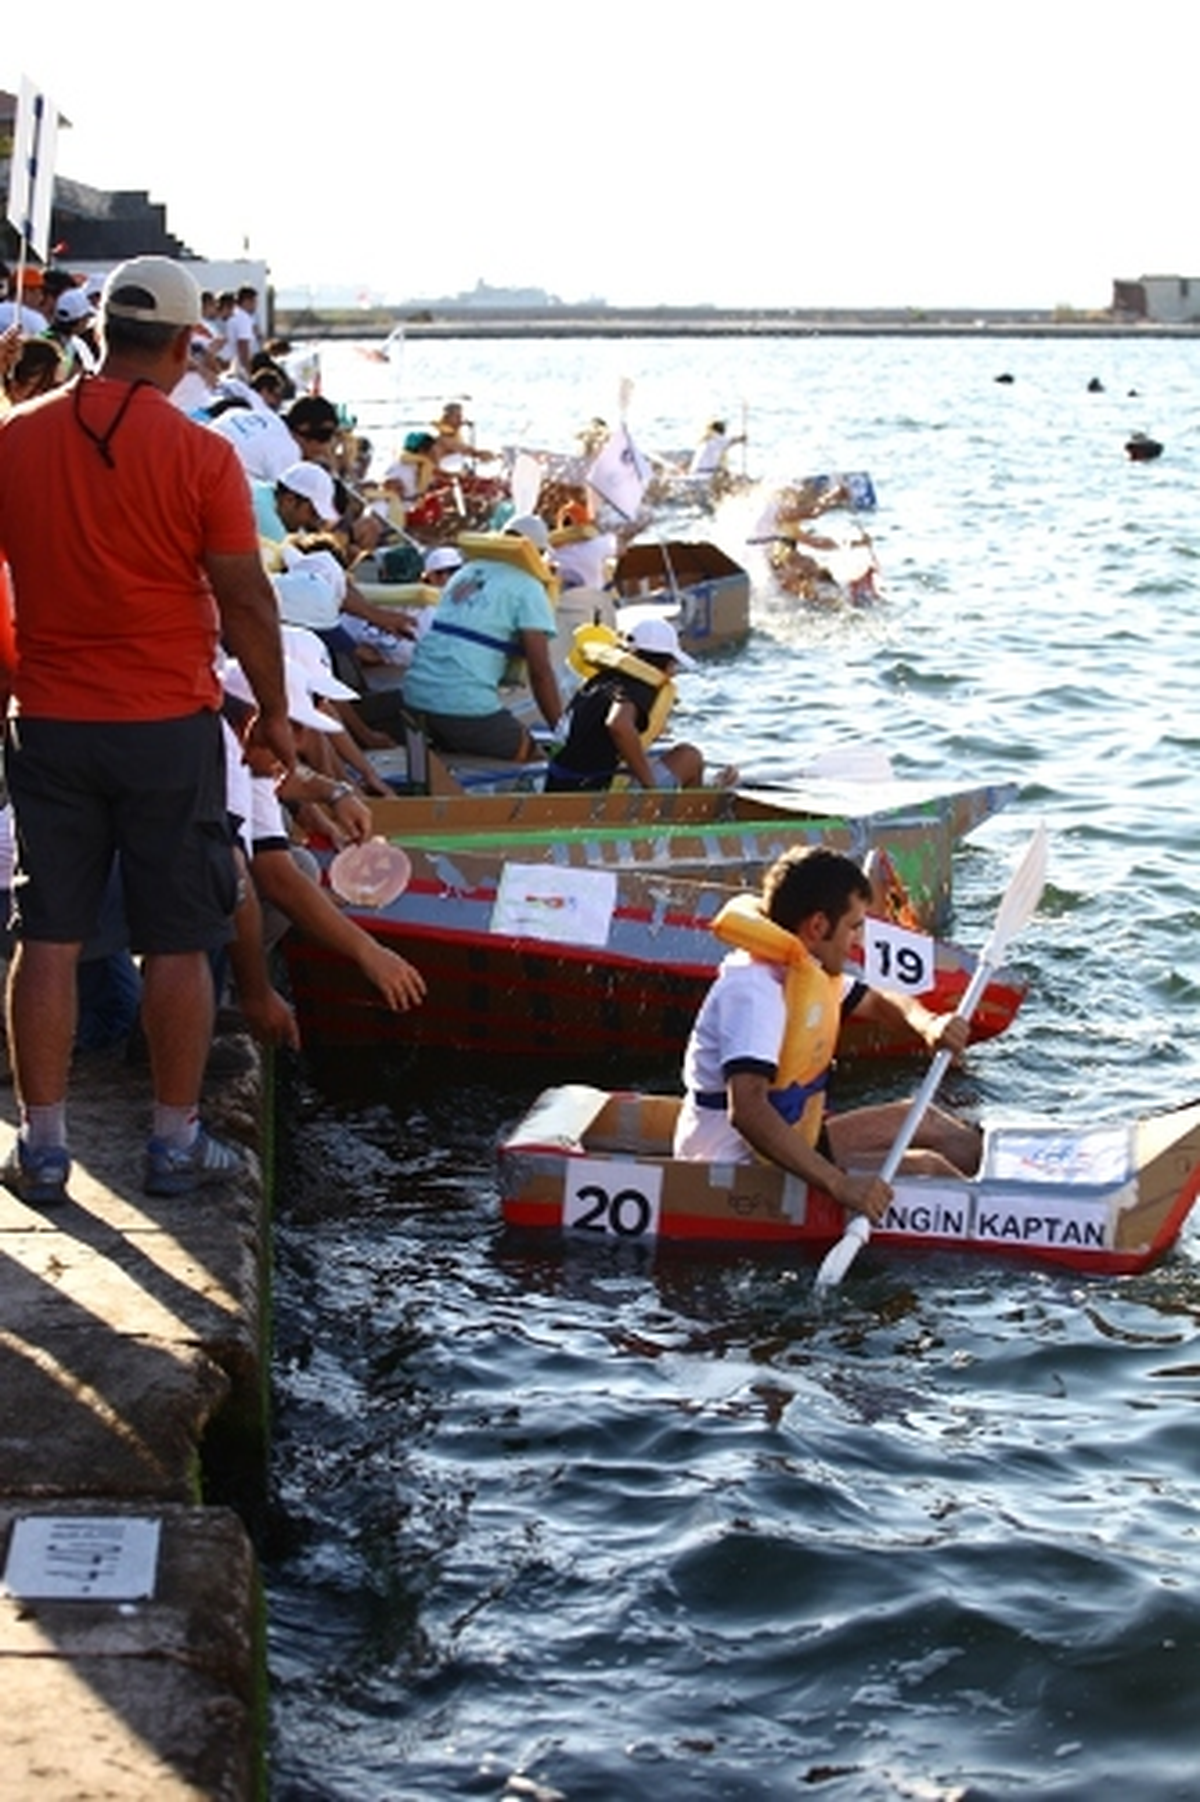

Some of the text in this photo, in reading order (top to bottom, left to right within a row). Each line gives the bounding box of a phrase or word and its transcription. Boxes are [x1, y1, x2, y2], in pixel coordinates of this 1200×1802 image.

[874, 941, 924, 984] 19
[573, 1185, 651, 1237] 20
[876, 1204, 1105, 1246] NGİN KAPTAN
